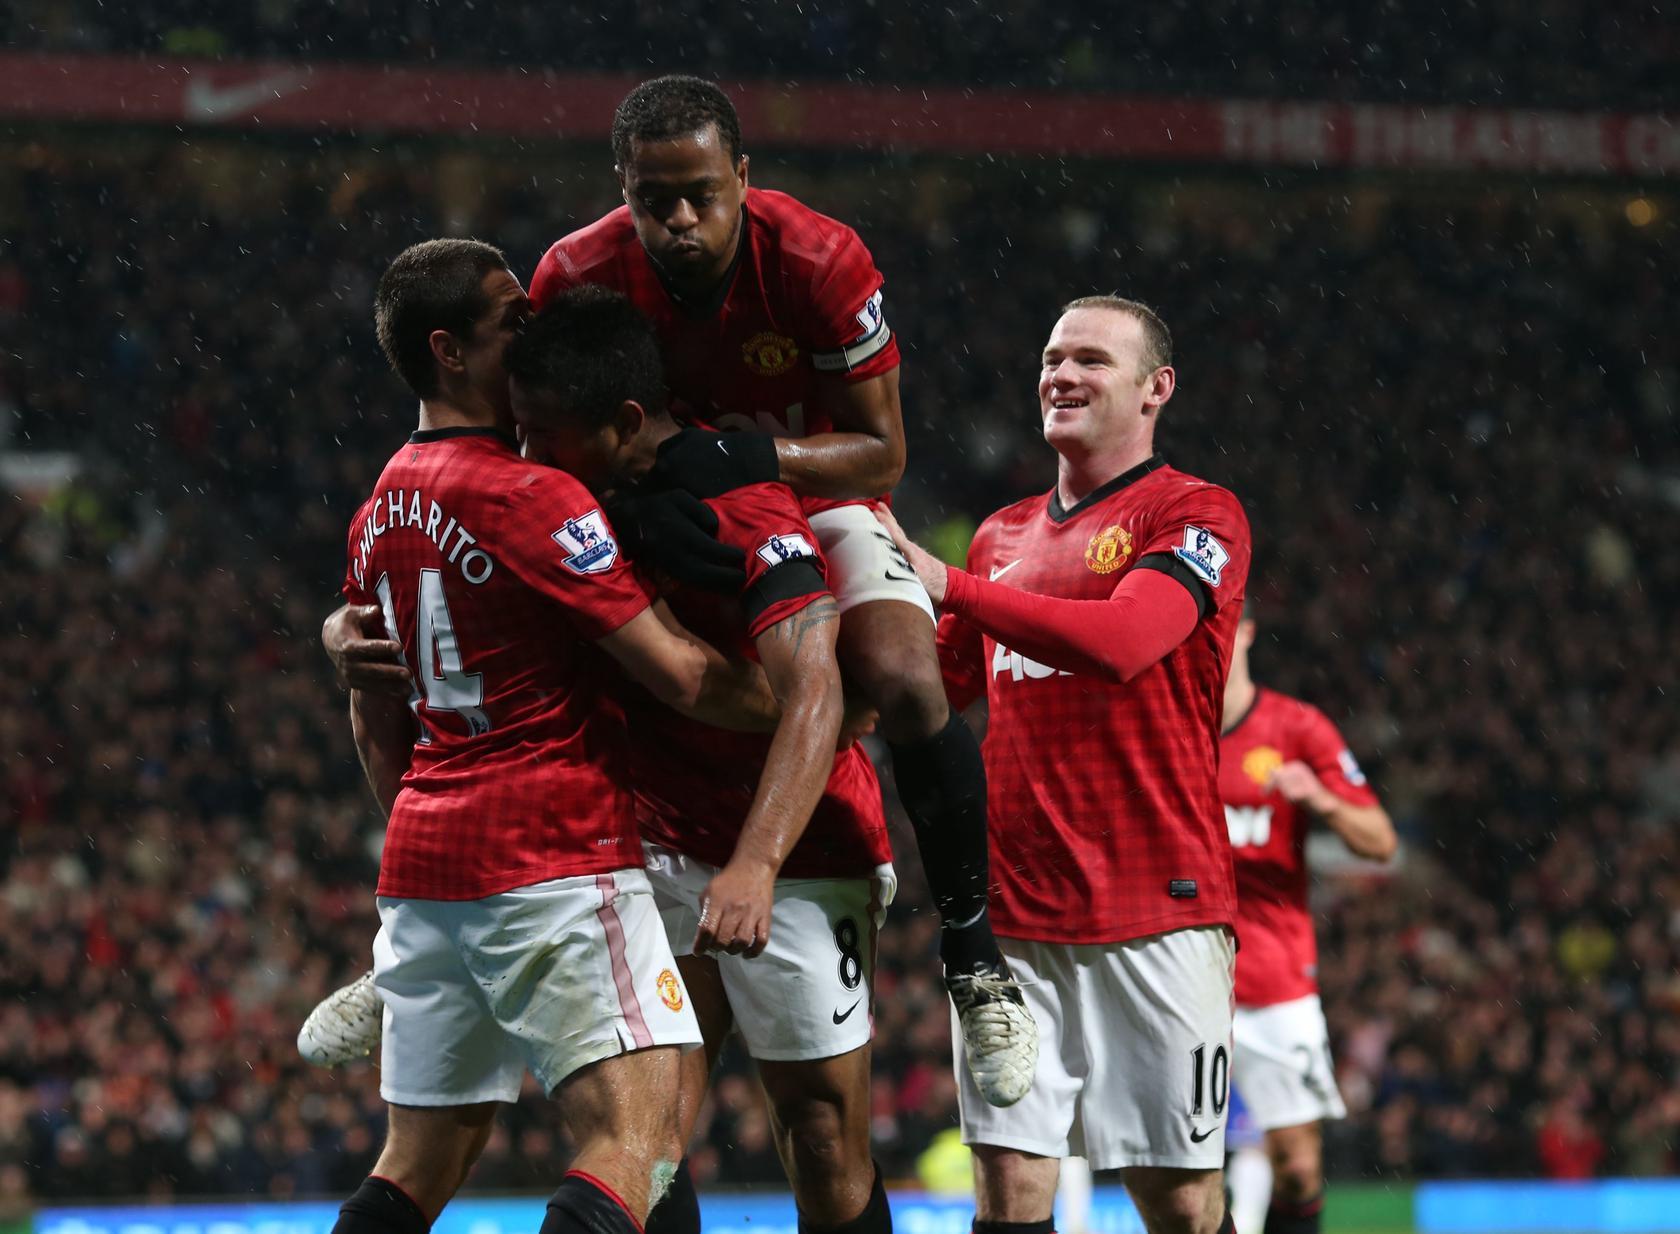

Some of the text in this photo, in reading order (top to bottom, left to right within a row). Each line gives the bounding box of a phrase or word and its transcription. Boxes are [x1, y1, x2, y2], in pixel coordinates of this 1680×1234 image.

[374, 567, 484, 742] 14
[832, 917, 863, 992] 8
[1190, 1043, 1228, 1118] 10
